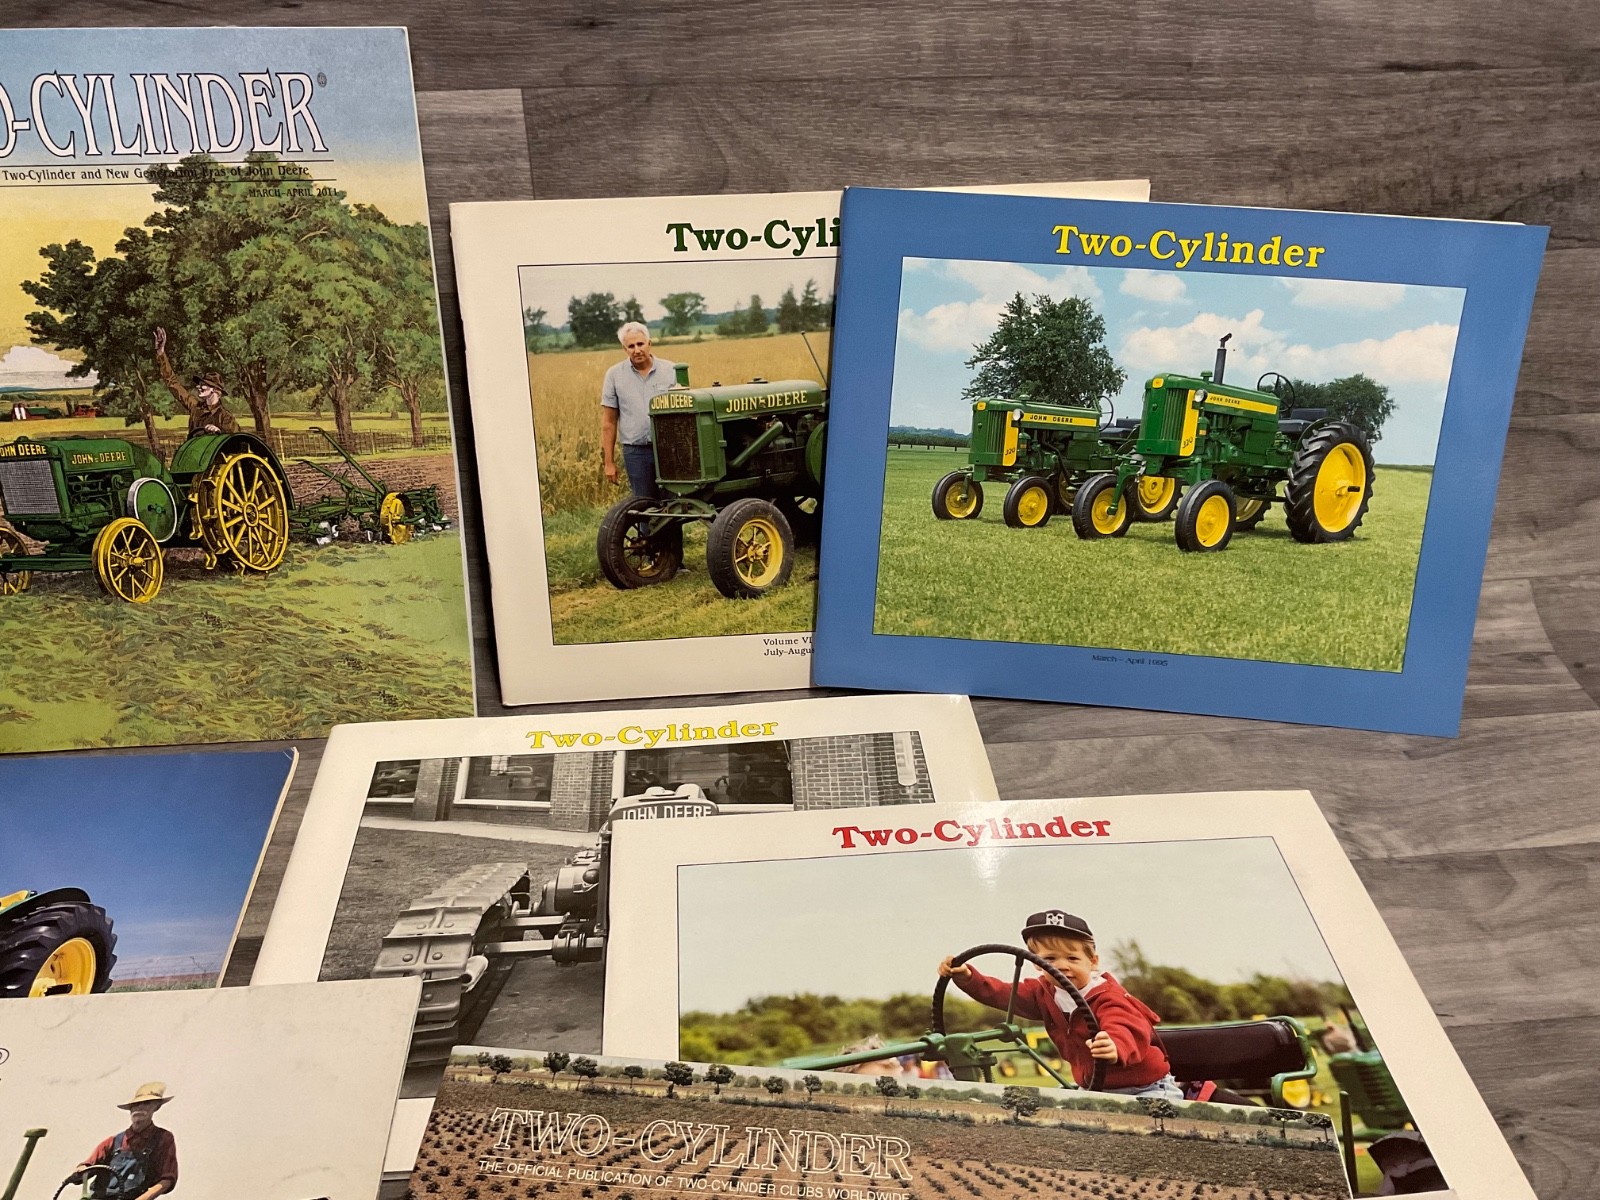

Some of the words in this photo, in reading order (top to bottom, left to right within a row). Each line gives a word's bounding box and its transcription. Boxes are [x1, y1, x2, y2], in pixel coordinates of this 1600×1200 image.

[2, 168, 77, 183] Two-Cylinder
[81, 168, 102, 180] and
[106, 168, 129, 180] New
[202, 166, 226, 177] Eras
[231, 165, 242, 177] of
[246, 165, 273, 176] John
[278, 165, 310, 176] Deere
[248, 187, 313, 199] MARCH-APRIL
[317, 187, 338, 197] 2011
[665, 217, 841, 257] Two-Cyli
[1051, 224, 1326, 269] Two-Cylinder
[651, 394, 670, 410] JOHN
[670, 393, 694, 409] DEERE
[726, 396, 758, 413] JOHN
[767, 390, 808, 407] DEERE
[1224, 397, 1241, 405] DEERE
[1029, 414, 1047, 422] JOHN
[1052, 416, 1073, 424] DEERE
[17, 443, 47, 456] DEERE
[71, 453, 94, 465] JOHN
[100, 451, 127, 463] DEERE
[763, 638, 798, 646] Volume
[1092, 654, 1117, 662] March
[1125, 657, 1145, 665] April
[525, 720, 779, 749] Two-Cylinder
[622, 806, 658, 821] JOHN
[832, 815, 1111, 849] Two-Cylinder
[490, 1106, 913, 1180] TWO-CYLINDER
[478, 1160, 502, 1173] THE
[506, 1162, 563, 1179] OFFICIAL
[567, 1168, 652, 1186] PUBLICATION
[655, 1175, 674, 1188] OF
[678, 1177, 776, 1196] TWO-CYLINDER
[780, 1184, 824, 1199] CLUBS
[828, 1188, 911, 1200] WORLDWIDE
